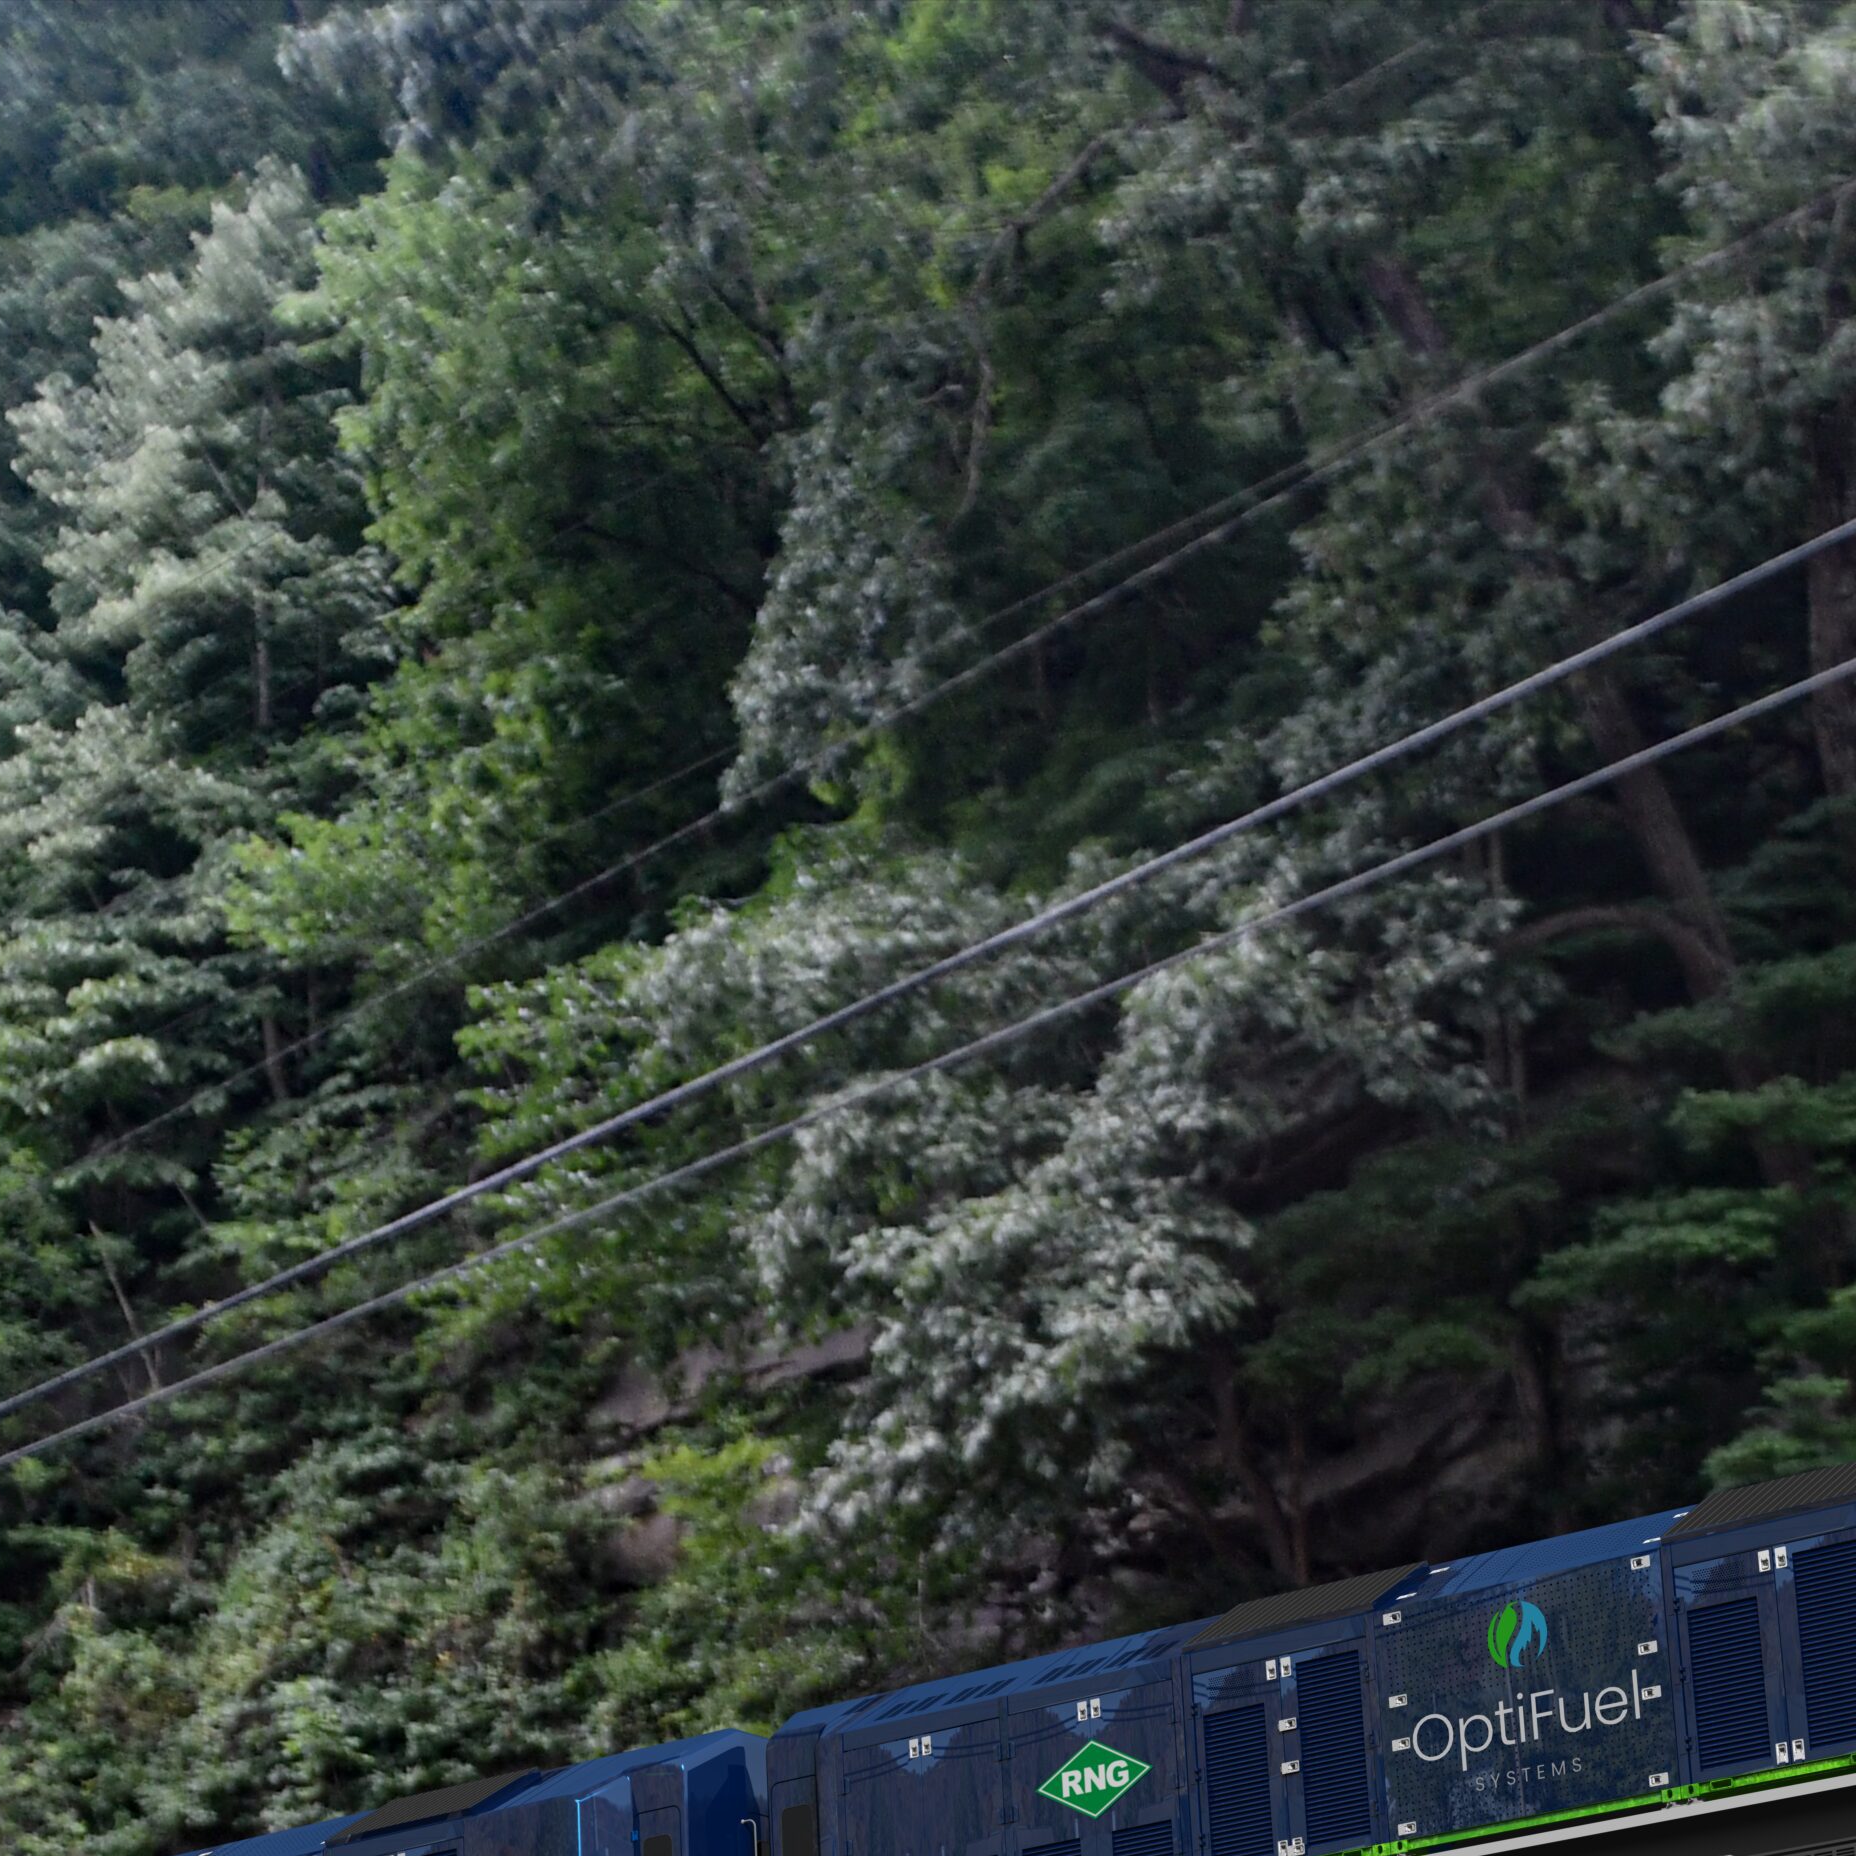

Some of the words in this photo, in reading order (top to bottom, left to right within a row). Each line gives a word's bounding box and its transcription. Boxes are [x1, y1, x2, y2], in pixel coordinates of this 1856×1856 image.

[1412, 1669, 1641, 1772] OptiFuel
[1061, 1760, 1130, 1798] RNG
[1475, 1757, 1583, 1791] SYSTEMS
